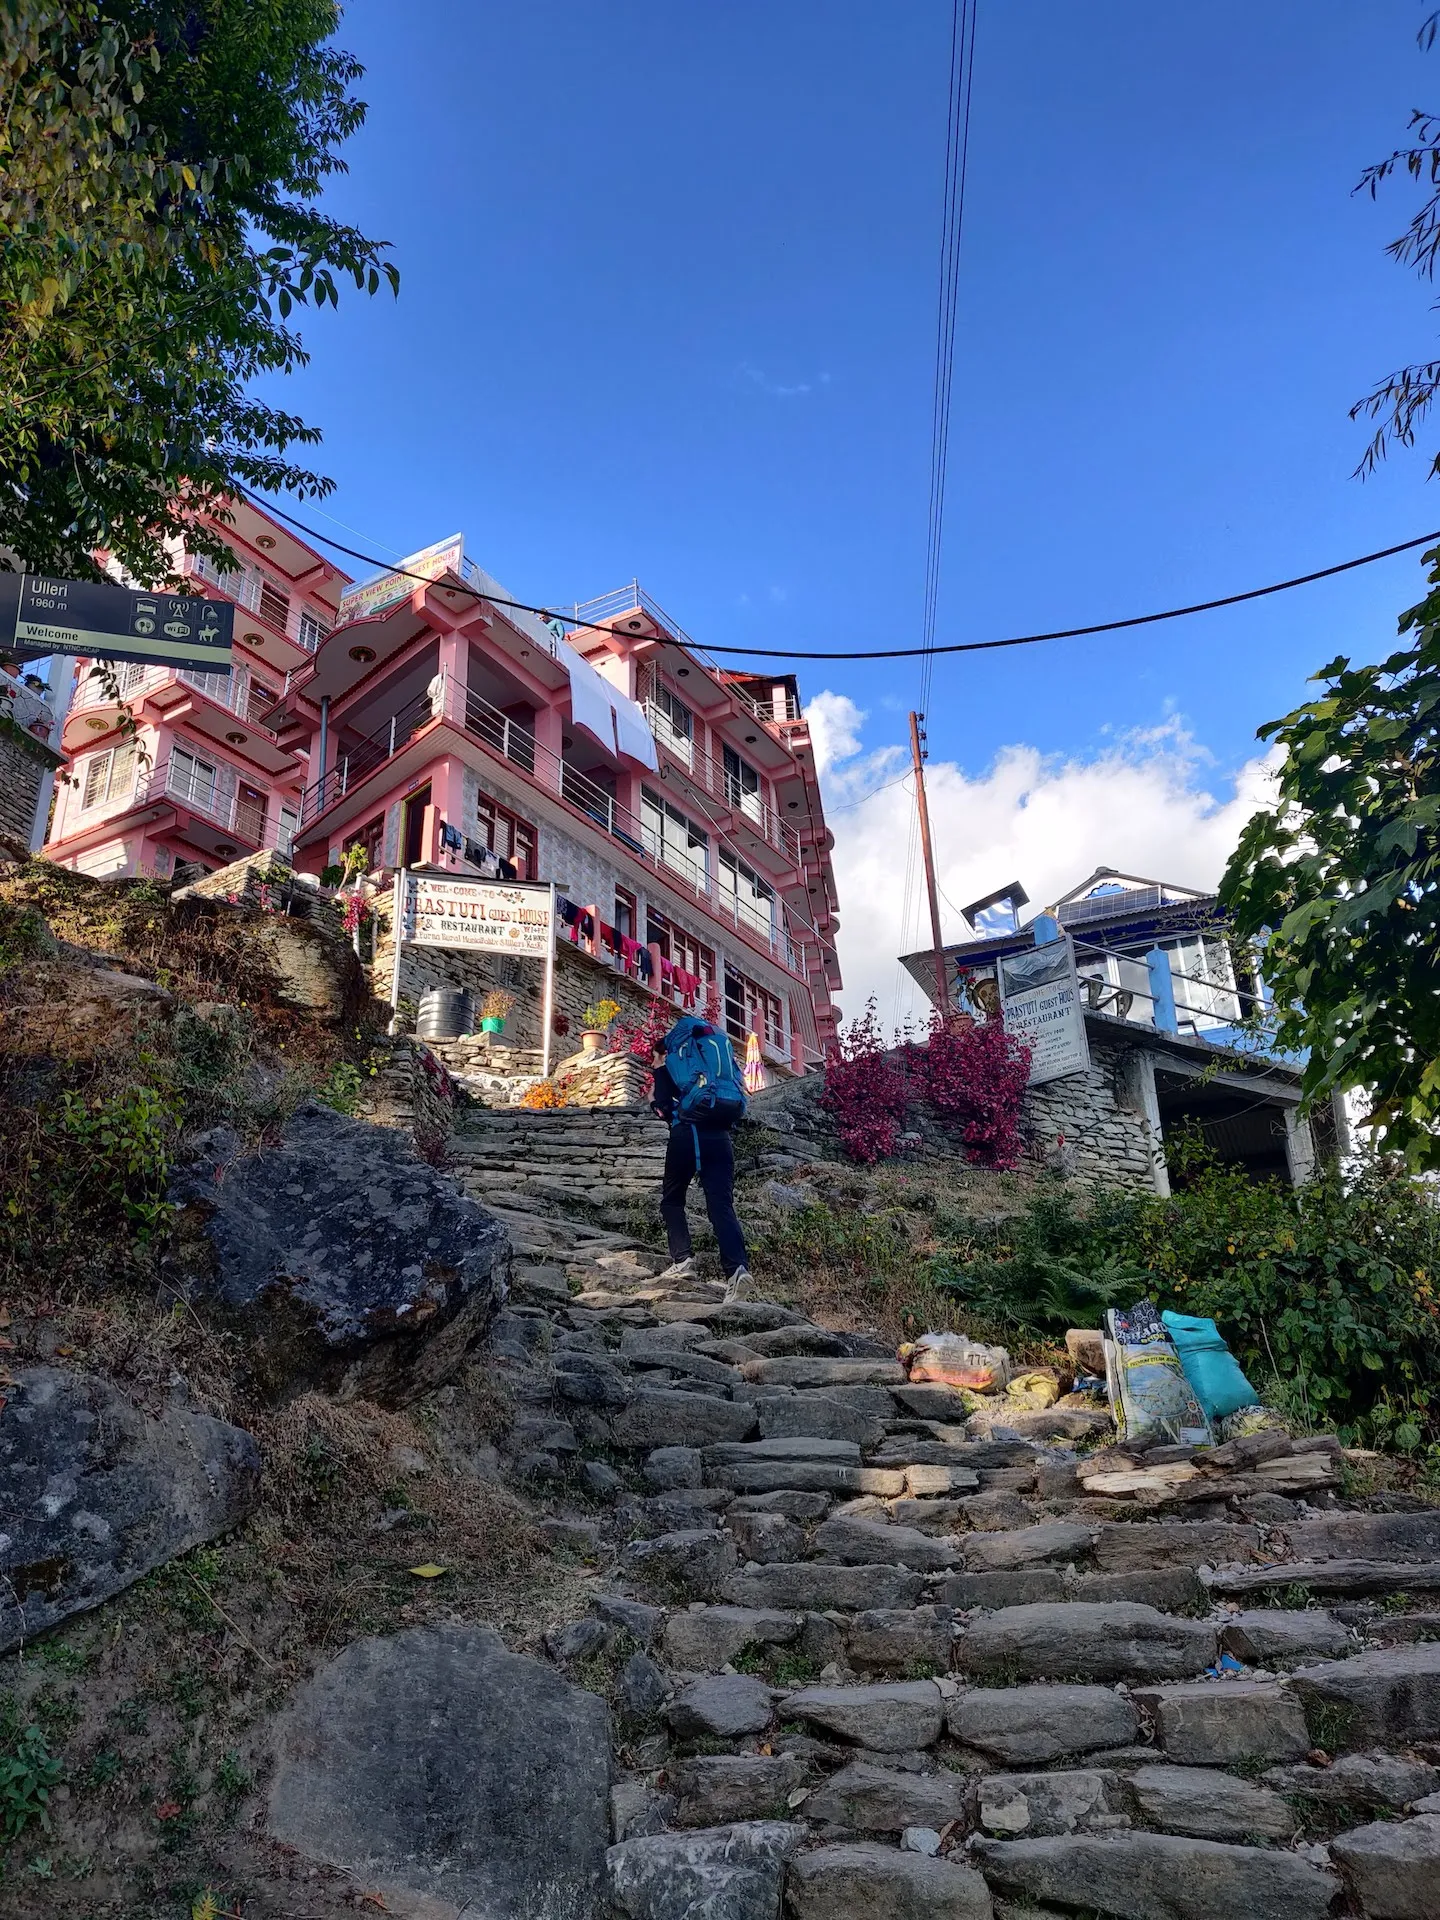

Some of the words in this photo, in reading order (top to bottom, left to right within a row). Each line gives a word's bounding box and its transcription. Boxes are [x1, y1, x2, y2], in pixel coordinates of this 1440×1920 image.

[342, 592, 364, 608] SUPER
[365, 584, 390, 597] VIEW
[384, 574, 406, 589] POINT
[432, 550, 456, 566] HOUSE
[31, 580, 68, 597] Ulleri
[30, 597, 55, 609] 1960
[57, 602, 68, 610] m
[26, 625, 79, 641] Welcome
[23, 639, 52, 649] Managed
[52, 642, 61, 651] by
[404, 896, 487, 920] PRASTUTI
[488, 908, 518, 923] GUEST
[518, 907, 549, 927] HOUSE
[425, 918, 437, 930] &
[440, 919, 505, 936] RESTAURANT
[441, 933, 461, 942] Rural
[1006, 999, 1038, 1021] PRASTUTI
[1039, 996, 1058, 1011] GUEST
[1016, 1006, 1072, 1029] RESTAURANT
